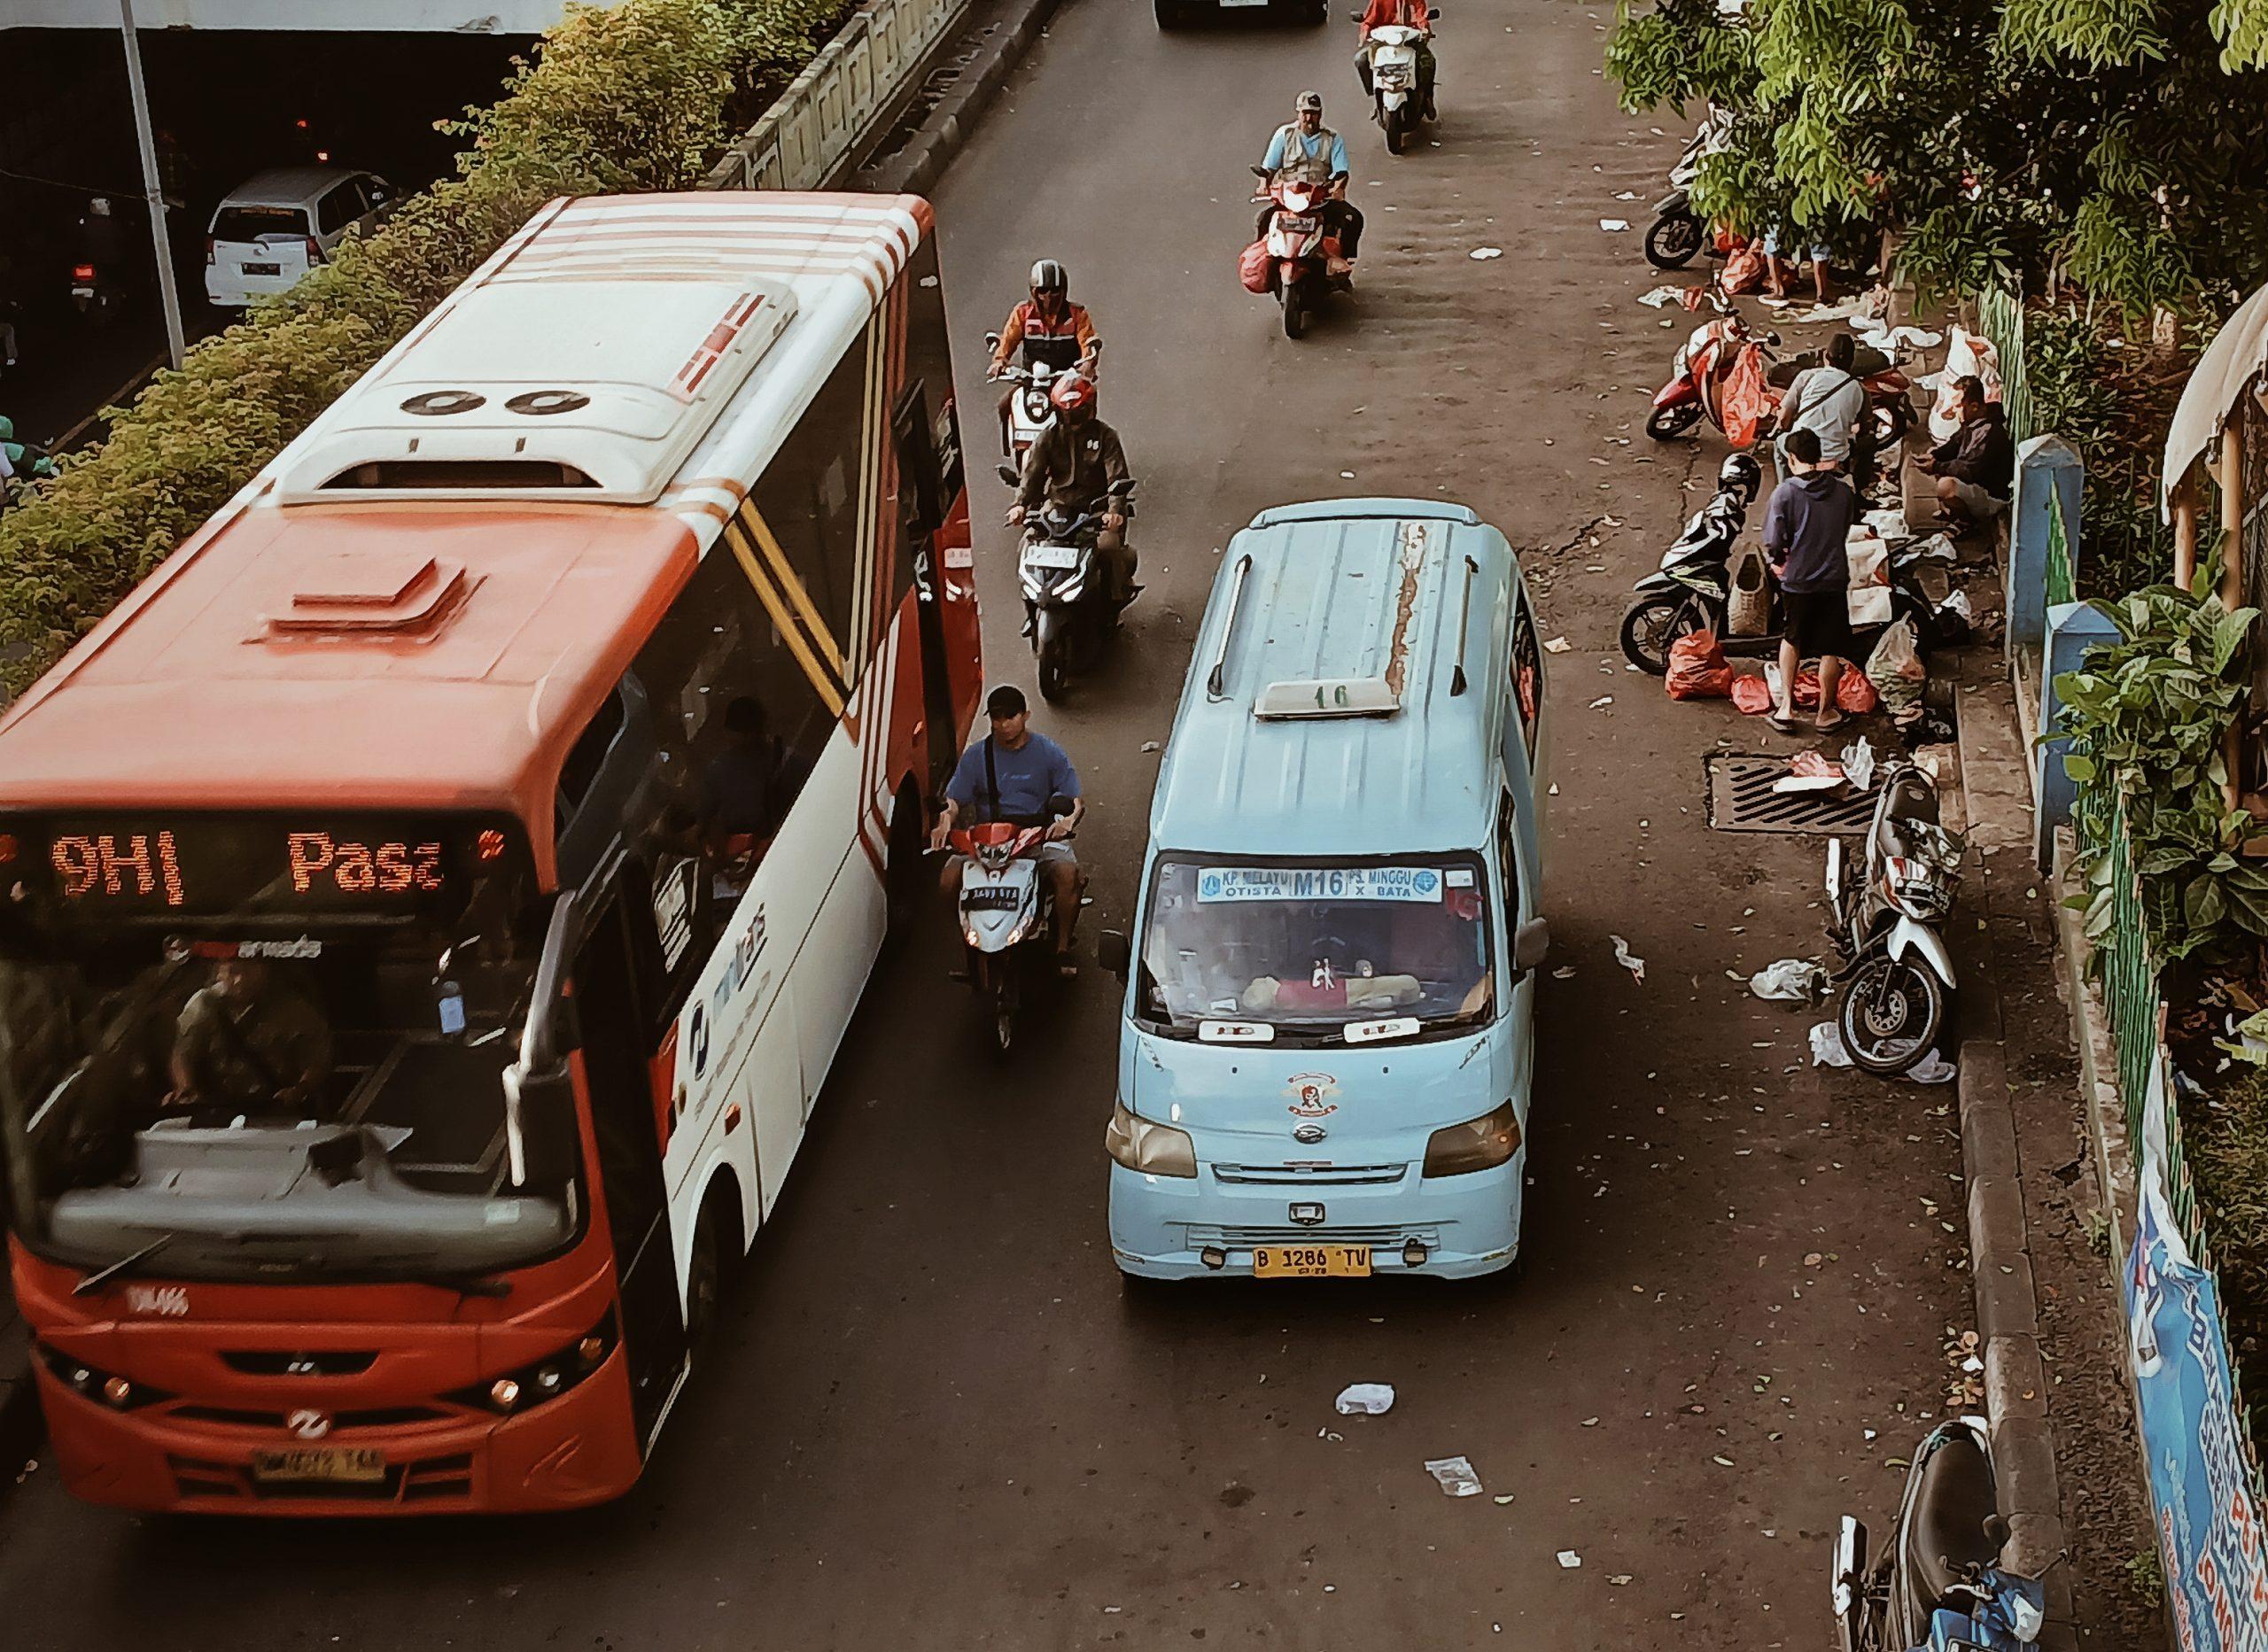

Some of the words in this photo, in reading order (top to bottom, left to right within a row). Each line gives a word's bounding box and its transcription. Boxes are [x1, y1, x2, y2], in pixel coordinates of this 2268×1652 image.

[1293, 871, 1343, 896] M16
[1369, 869, 1411, 886] MINGGU
[1225, 887, 1282, 896] OTISTA
[1377, 886, 1410, 897] BATA
[1257, 1250, 1269, 1268] B
